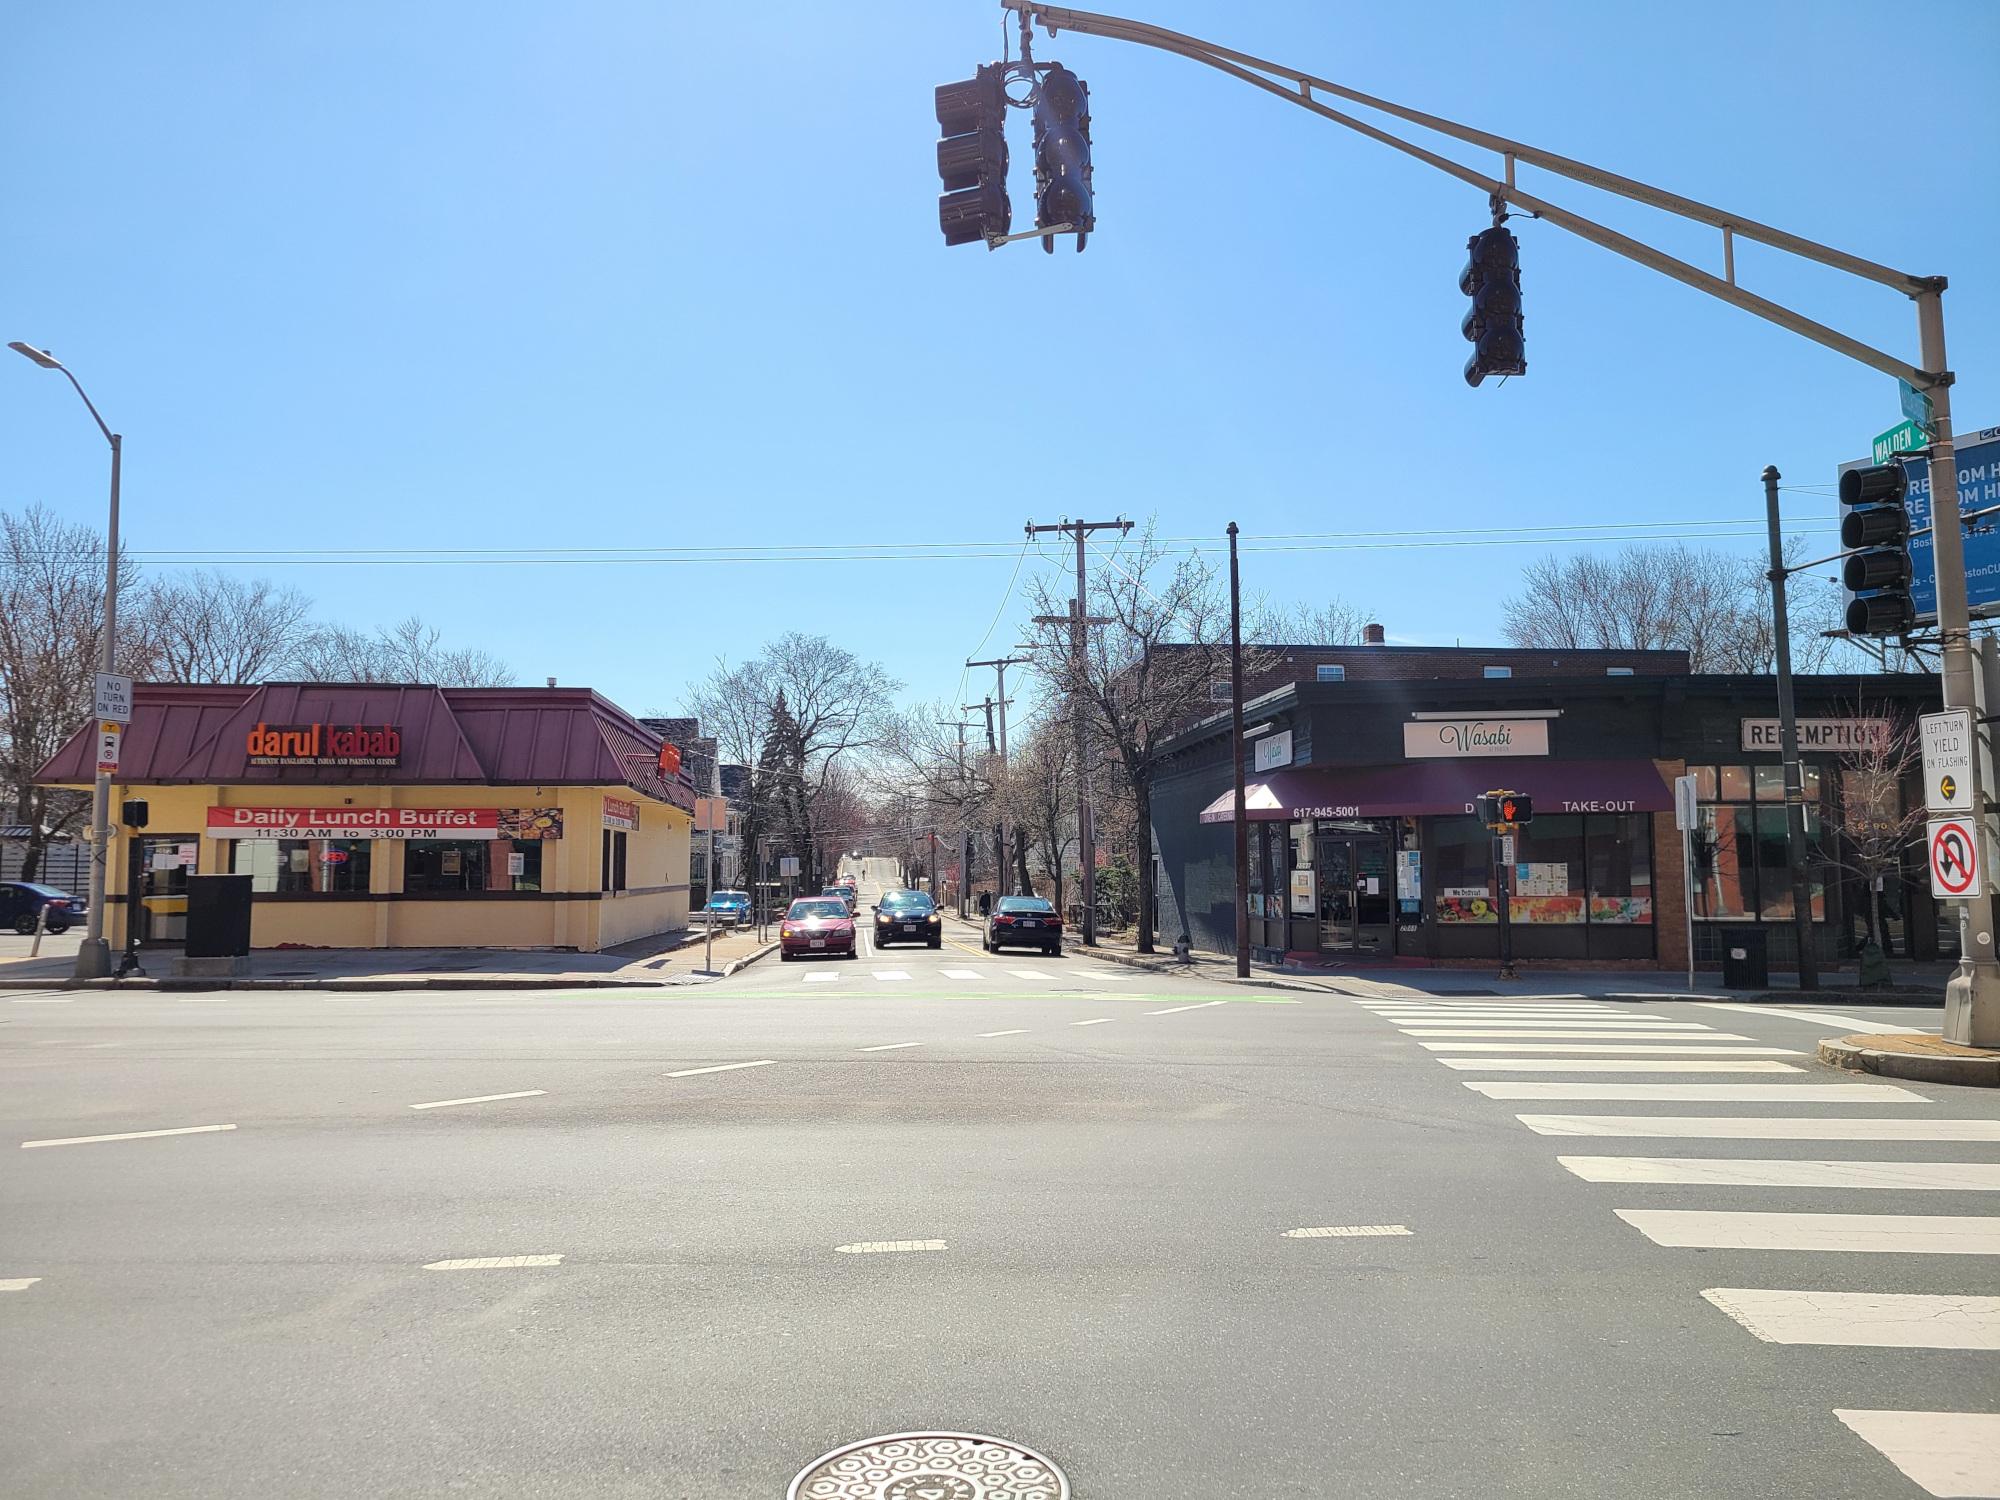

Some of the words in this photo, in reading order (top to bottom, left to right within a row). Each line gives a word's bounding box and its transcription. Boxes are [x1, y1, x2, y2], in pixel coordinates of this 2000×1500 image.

[1874, 427, 1912, 463] WALDEN
[106, 681, 121, 692] NO
[103, 692, 125, 703] TURN
[97, 702, 109, 713] ON
[112, 704, 129, 715] RED
[1926, 722, 1942, 735] LEFT
[1943, 720, 1964, 733] TURN
[246, 722, 321, 756] darul
[326, 722, 401, 757] kabab
[1439, 722, 1512, 752] Wasabi
[1751, 725, 1880, 745] REEMPTION
[1933, 737, 1959, 753] YIELD
[337, 757, 348, 765] AND
[1926, 758, 1936, 769] ON
[1937, 755, 1968, 769] FLASHING
[1293, 806, 1360, 818] 617-945-5001
[1562, 800, 1636, 812] TAKE-OUT
[234, 808, 300, 828] Daily
[309, 809, 391, 825] Lunch
[399, 809, 478, 825] Buffet
[255, 828, 298, 838] 11:30
[303, 829, 332, 838] AM
[343, 829, 359, 838] to
[369, 829, 405, 838] 3:00
[411, 829, 437, 838] PM
